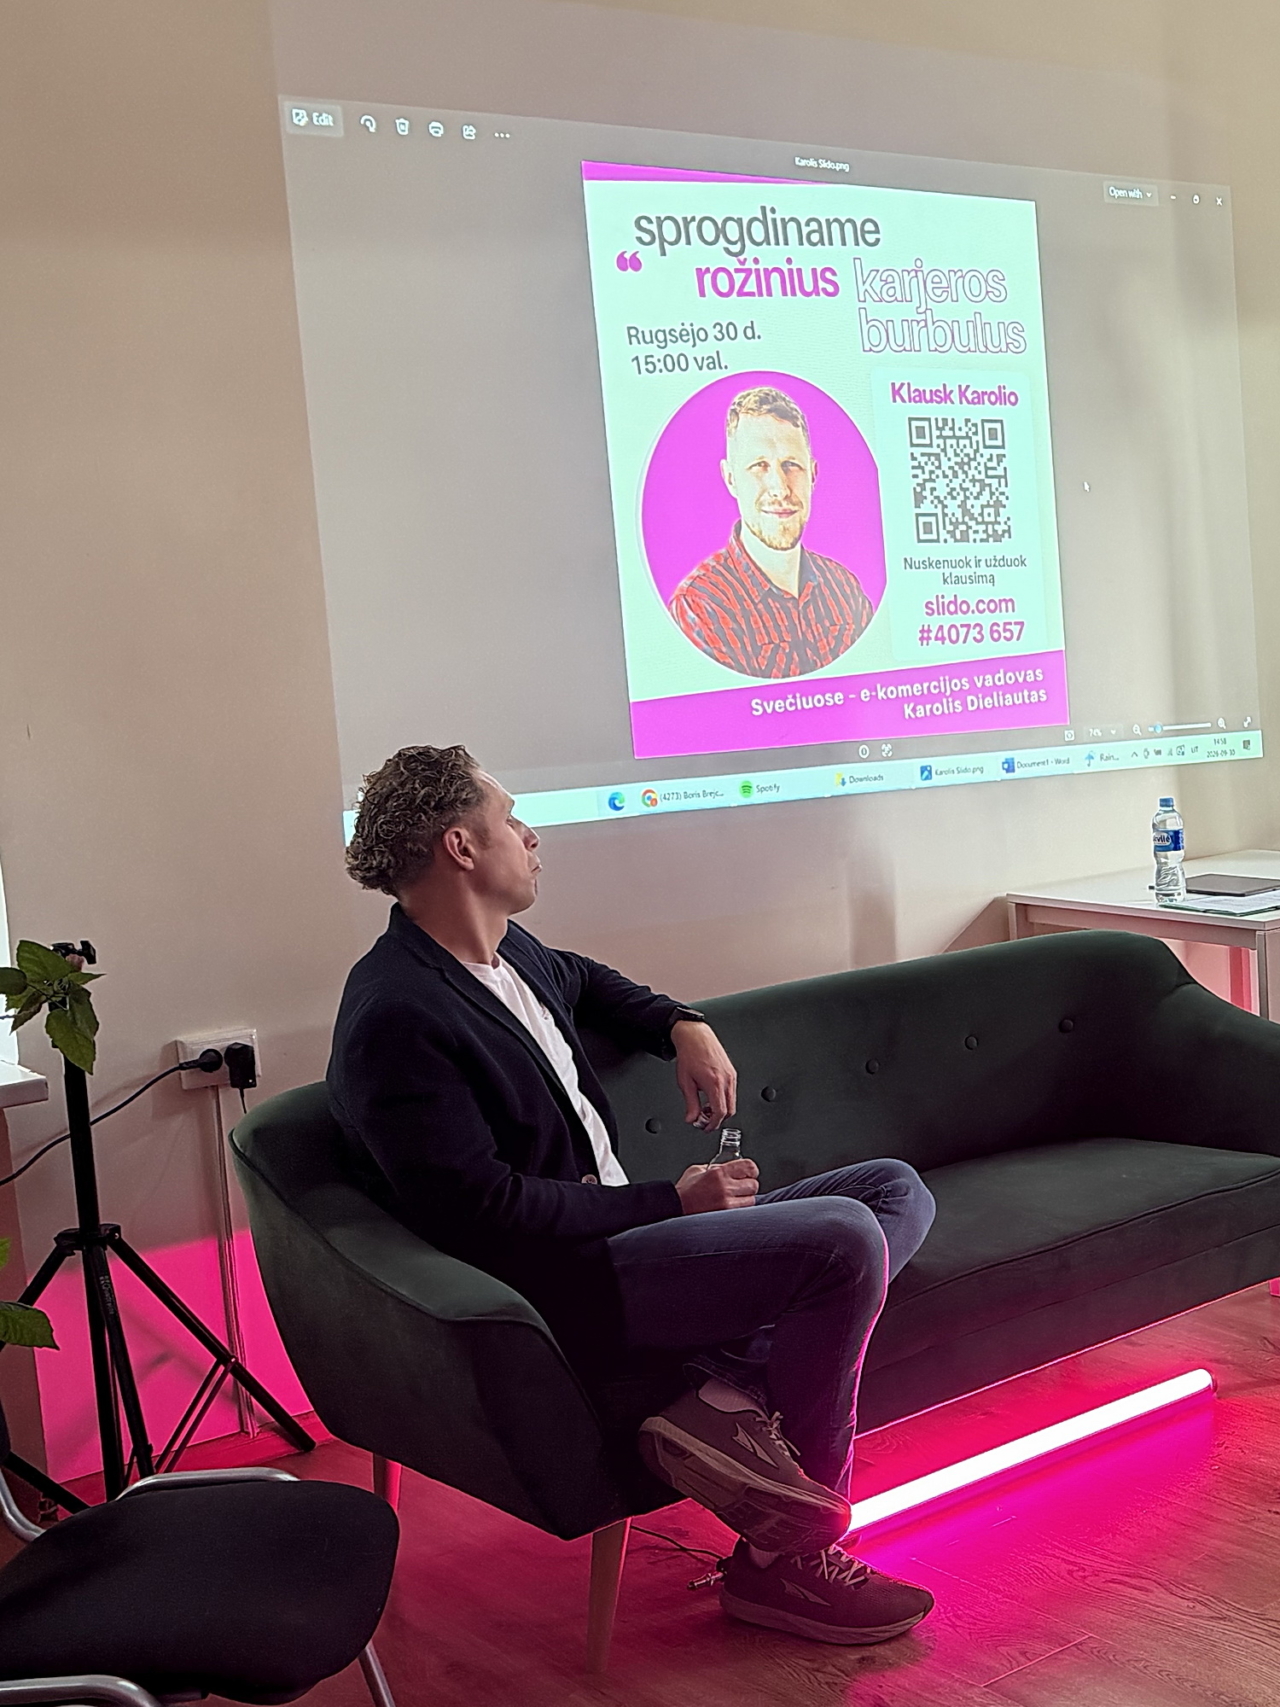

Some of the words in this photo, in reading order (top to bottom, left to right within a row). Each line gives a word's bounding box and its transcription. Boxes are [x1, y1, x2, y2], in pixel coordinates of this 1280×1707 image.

[313, 112, 334, 127] Edit
[1109, 186, 1128, 199] Open
[1128, 188, 1143, 199] with
[634, 205, 881, 258] sprogdiname
[695, 256, 840, 299] rožinius
[852, 257, 1008, 315] karjeros
[627, 322, 708, 349] Rugsėjo
[713, 322, 739, 342] 30
[743, 320, 762, 341] d.
[858, 308, 1028, 355] burbulus
[631, 352, 689, 376] 15:00
[694, 351, 729, 372] val.
[890, 382, 955, 405] Klausk
[957, 384, 1019, 407] Karolio
[903, 556, 972, 571] Nuskenuok
[974, 556, 983, 569] ir
[985, 555, 1027, 569] užduok
[942, 571, 996, 587] klausimą
[924, 595, 1016, 617] slido.com
[918, 622, 985, 647] #4073
[989, 621, 1025, 643] 657
[750, 690, 844, 717] Svečiuose
[860, 678, 970, 703] e-komercijos
[973, 667, 1044, 688] vadovas
[903, 699, 963, 720] Karolis
[967, 687, 1047, 712] Dieliautas
[755, 783, 781, 794] Spotify
[849, 774, 884, 784] Downloads
